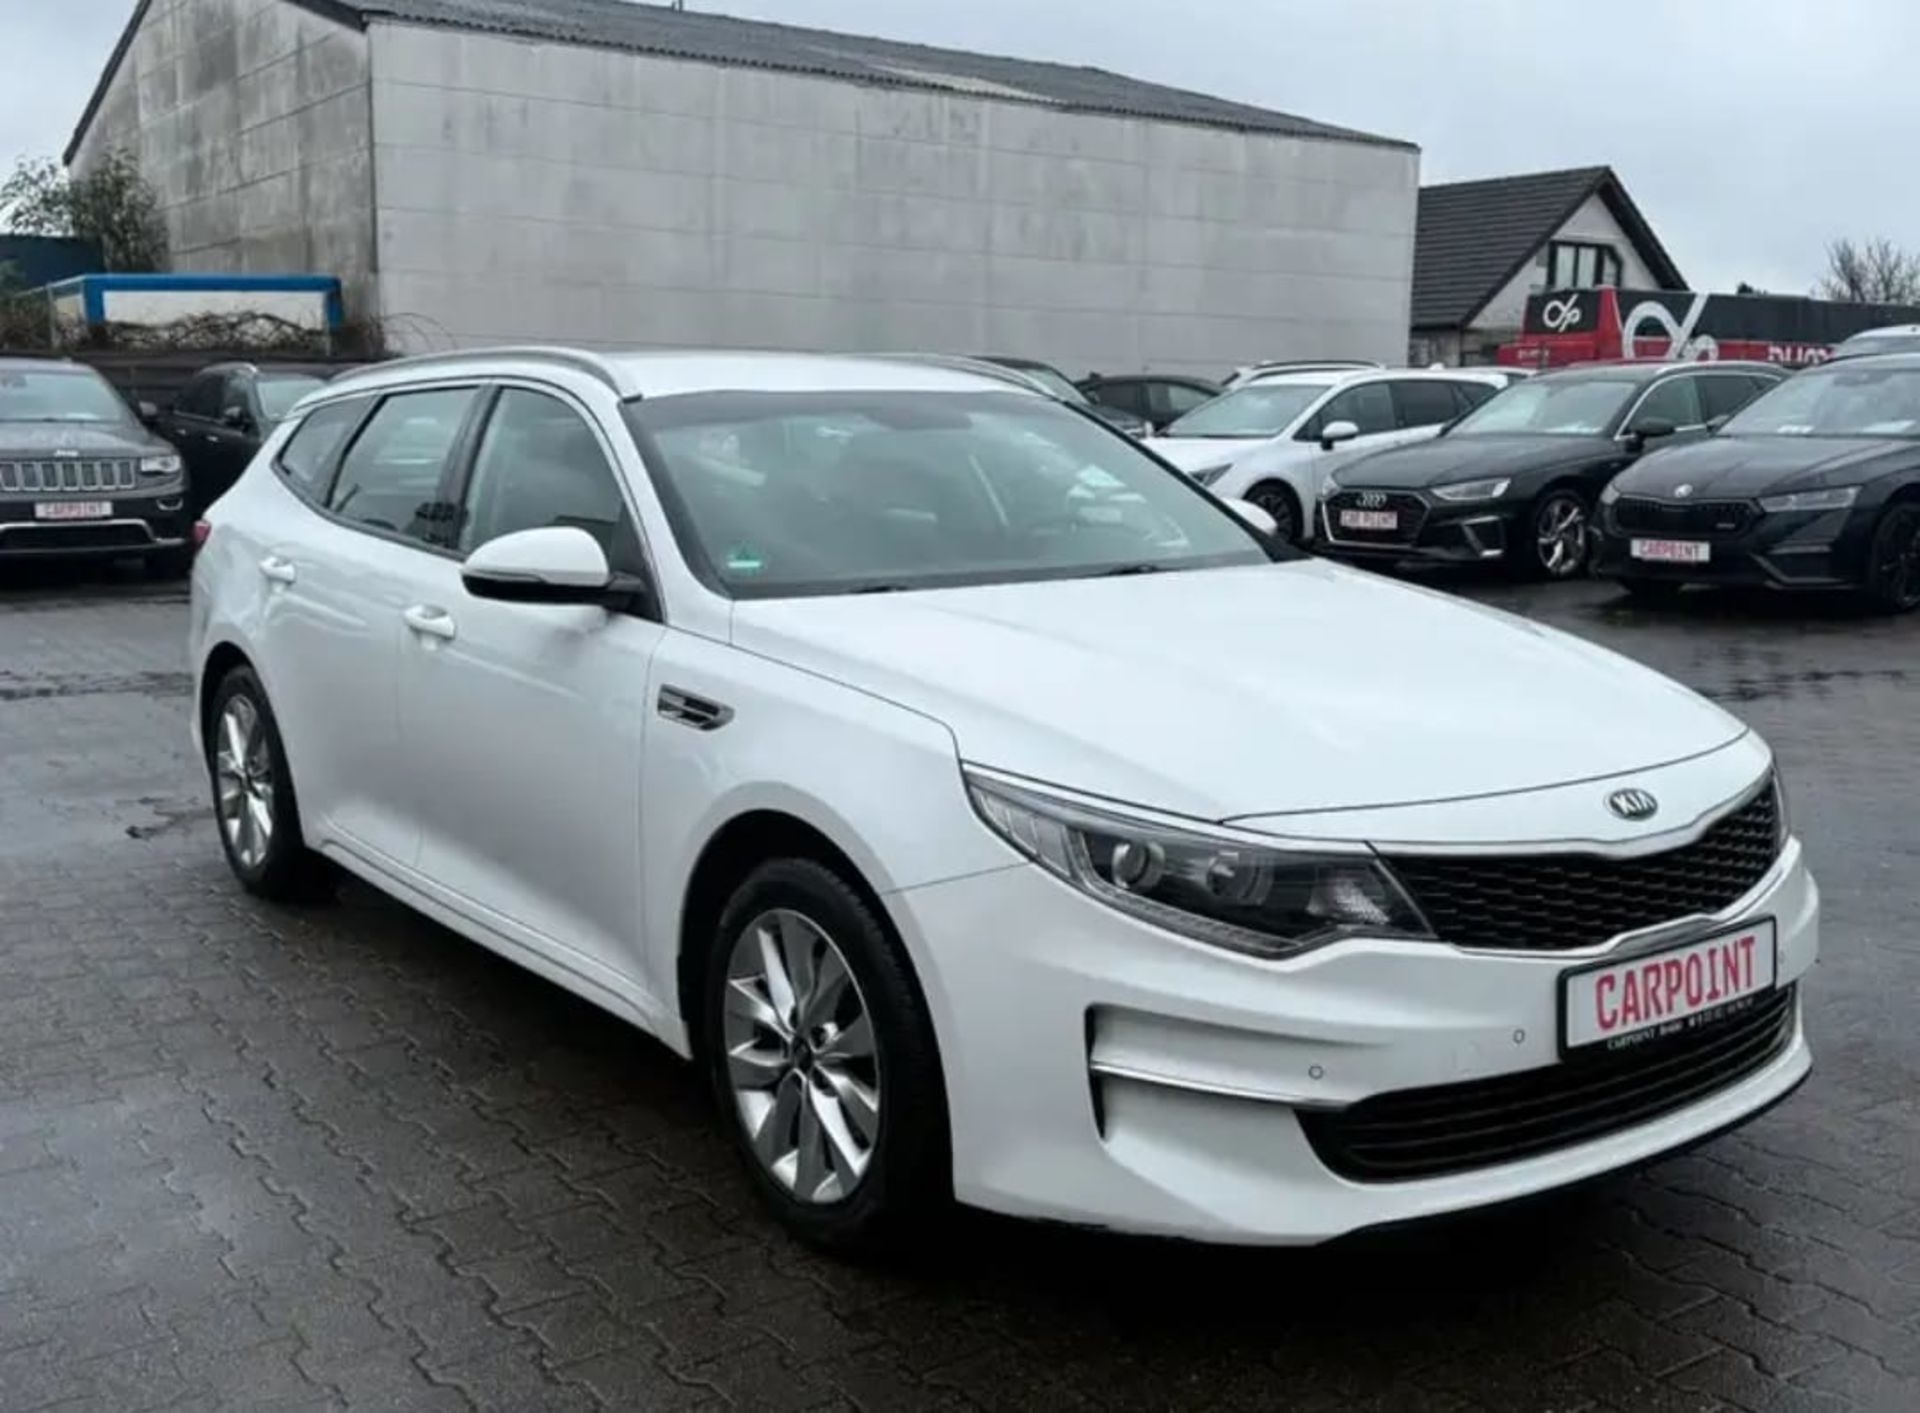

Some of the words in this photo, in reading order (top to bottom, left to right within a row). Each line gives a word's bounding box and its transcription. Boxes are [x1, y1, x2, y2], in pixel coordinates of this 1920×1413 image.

[1640, 541, 1701, 561] CARPOINT
[1612, 791, 1656, 816] KIA
[1595, 935, 1756, 1031] CARPOINT
